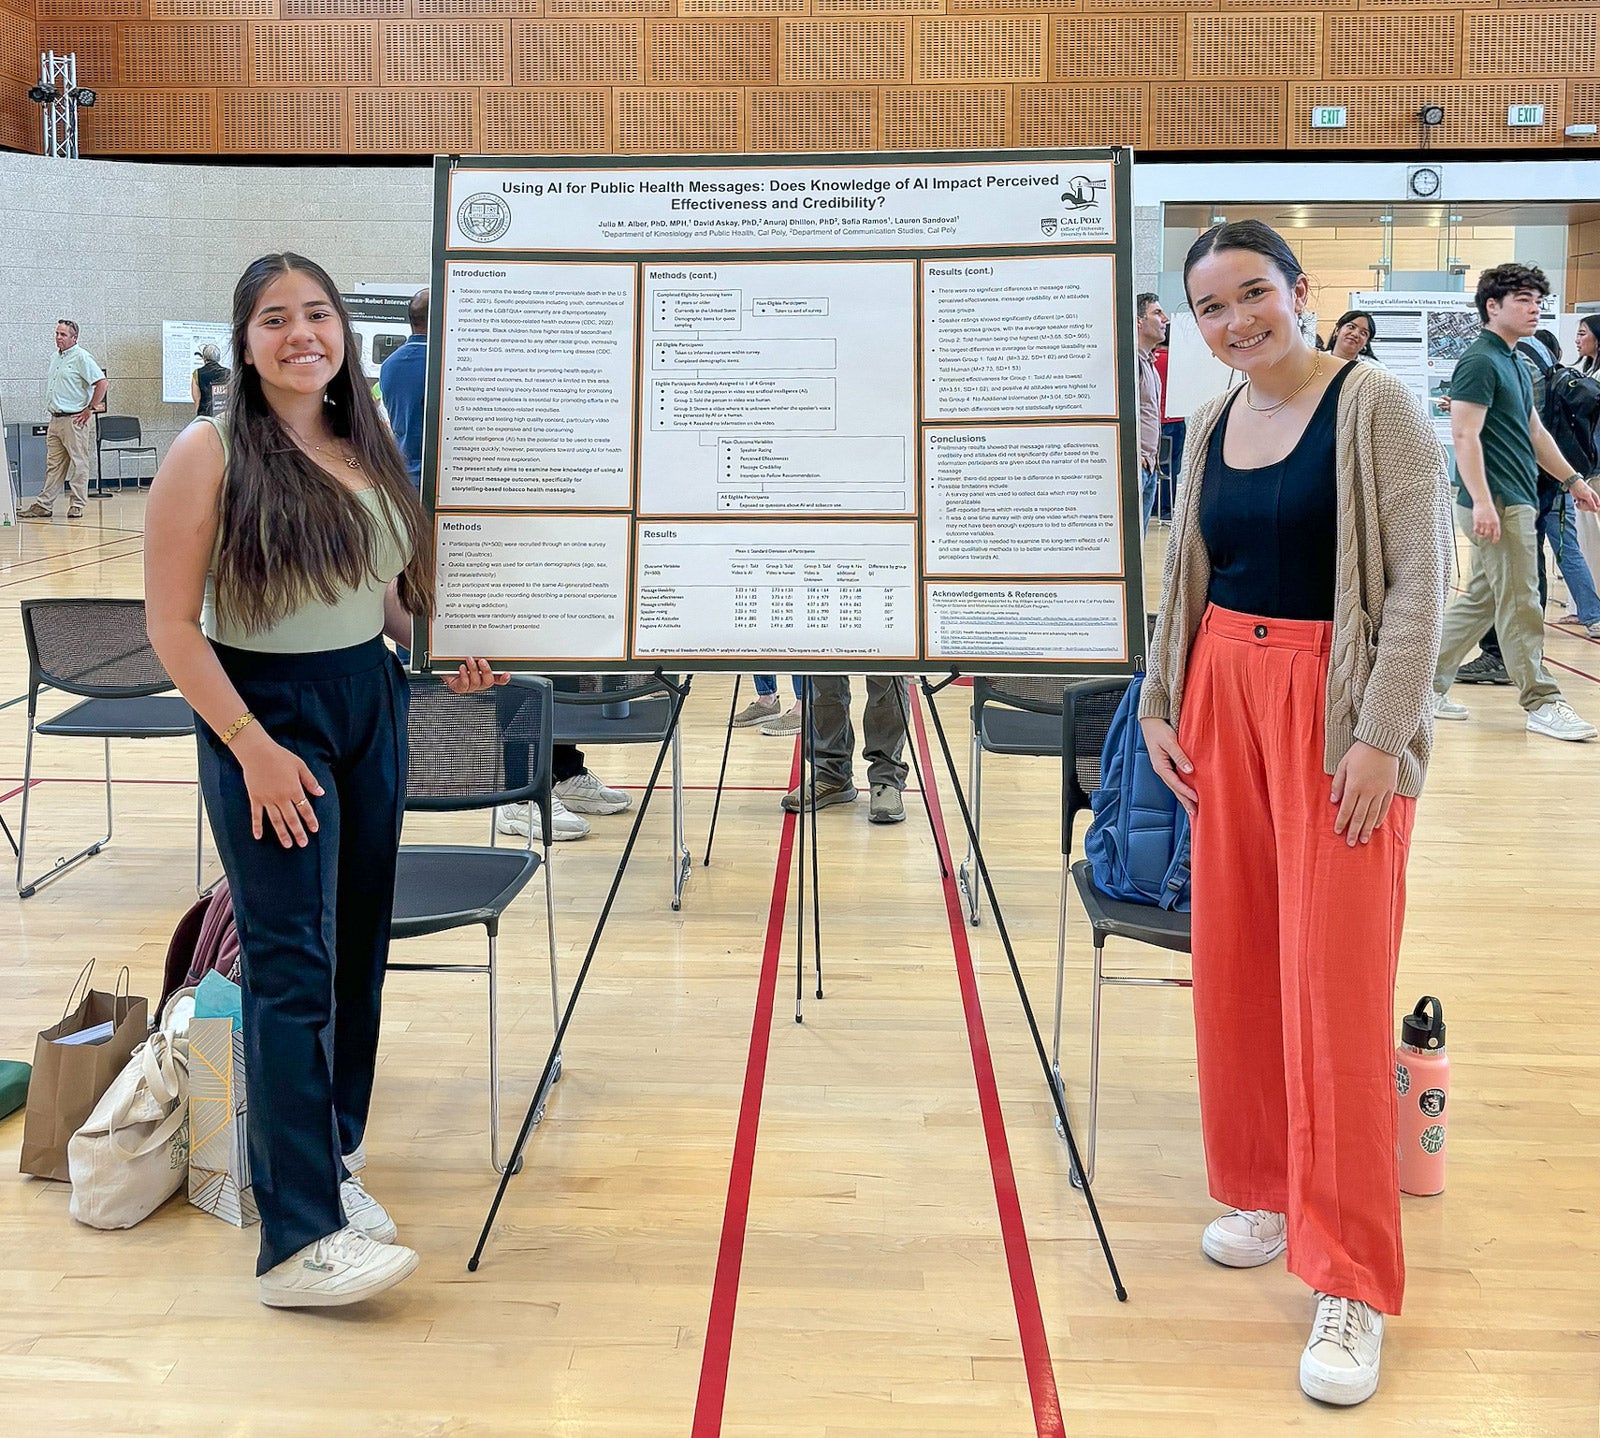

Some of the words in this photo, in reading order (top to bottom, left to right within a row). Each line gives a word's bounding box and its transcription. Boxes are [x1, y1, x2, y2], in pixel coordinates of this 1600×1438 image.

[1321, 110, 1340, 124] EXIT
[1518, 107, 1537, 122] EXIT
[503, 182, 543, 196] Using
[548, 182, 562, 193] AI
[567, 182, 586, 193] for
[591, 182, 634, 193] Public
[640, 181, 684, 192] Health
[689, 180, 764, 194] Messages:
[770, 180, 805, 191] Does
[811, 178, 890, 193] Knowledge
[896, 178, 909, 189] of
[914, 177, 928, 188] AI
[933, 176, 981, 190] Impact
[987, 175, 1059, 187] Perceived
[672, 198, 766, 210] Effectiveness
[772, 198, 798, 208] and
[803, 197, 885, 211] Credibility?
[965, 268, 993, 276] (cont.)
